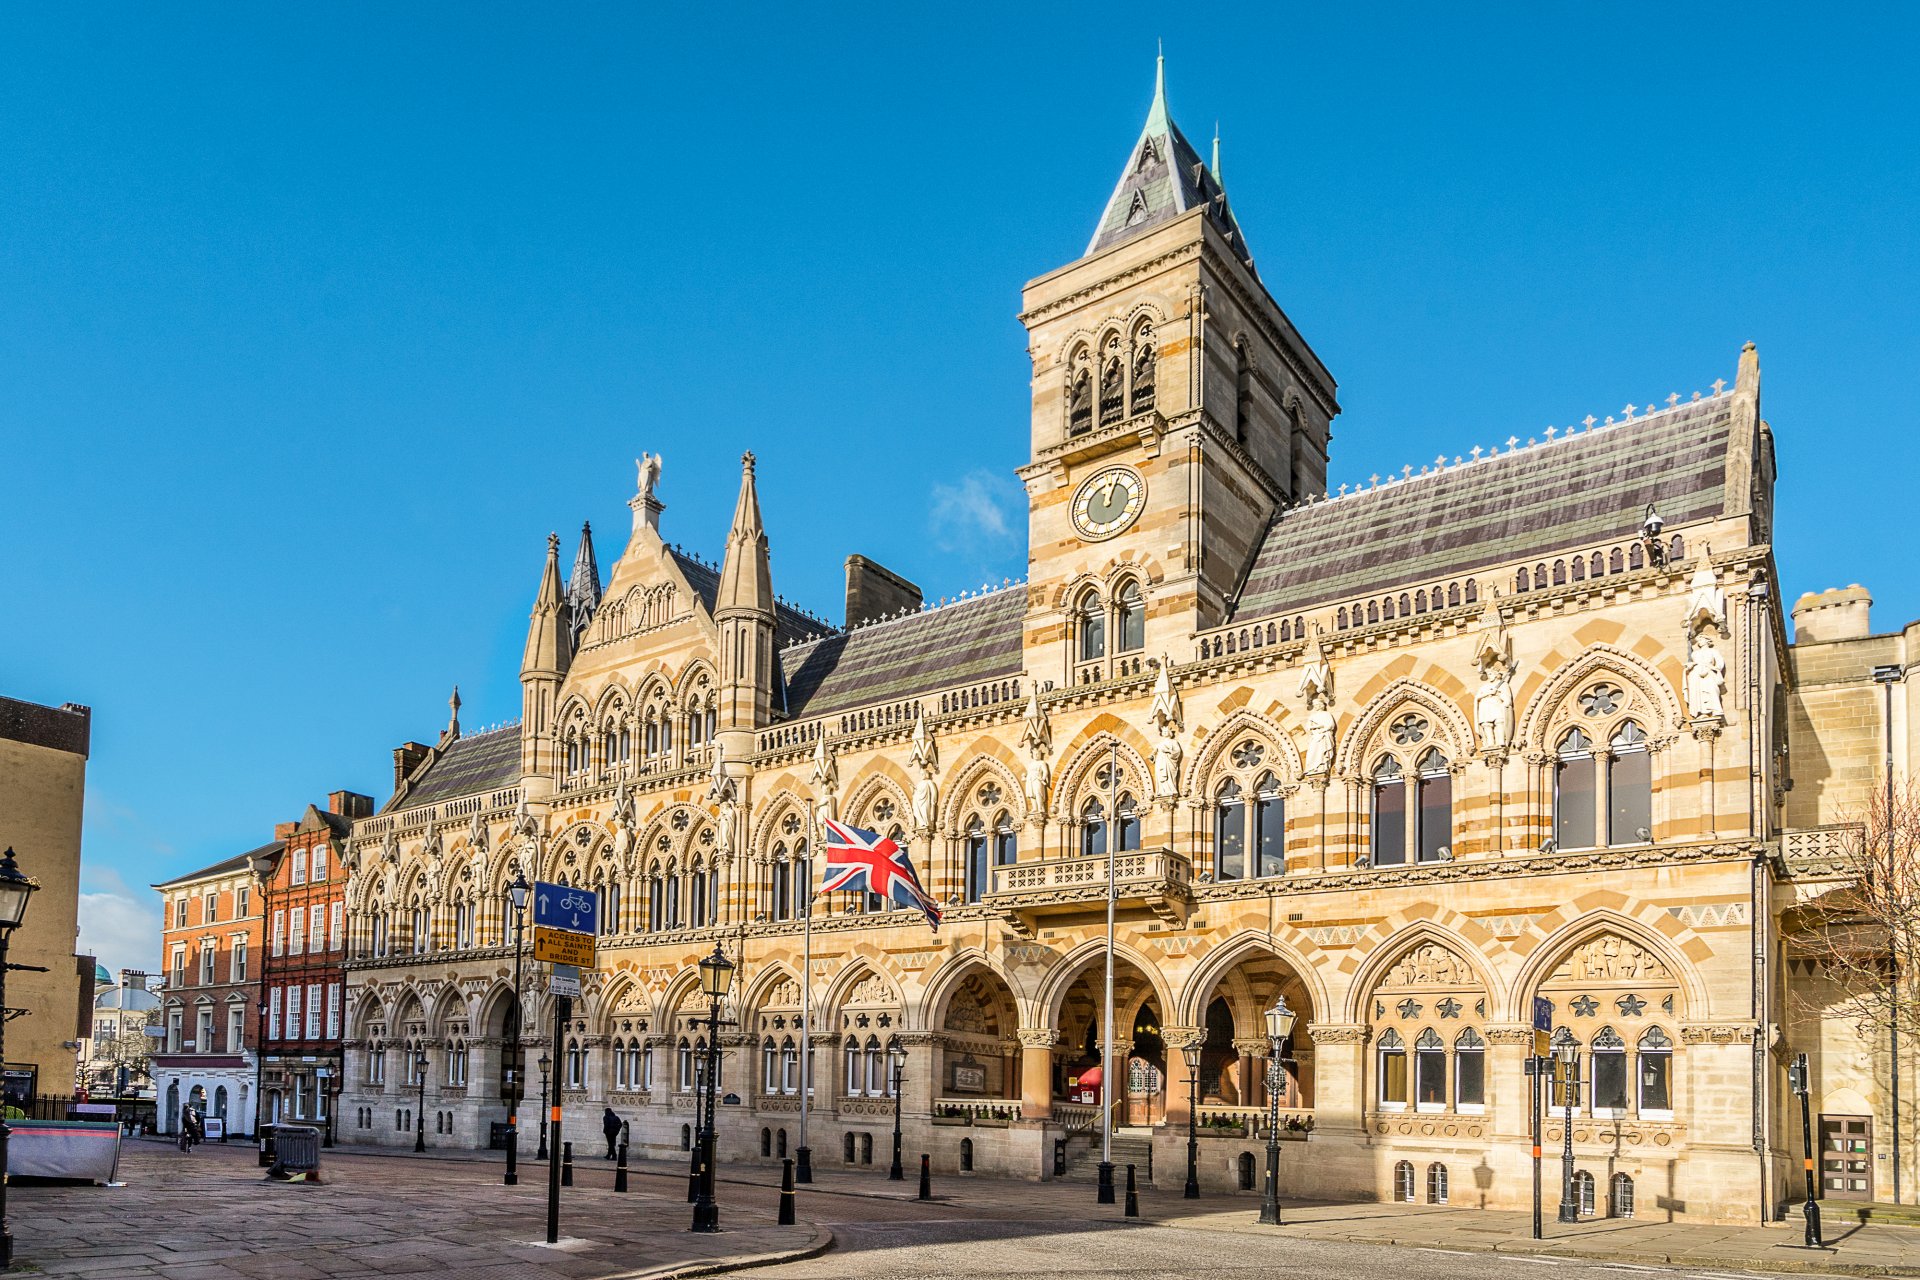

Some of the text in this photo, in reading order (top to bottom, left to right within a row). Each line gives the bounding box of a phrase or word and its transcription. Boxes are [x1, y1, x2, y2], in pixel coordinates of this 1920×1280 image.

[548, 932, 581, 942] ACCESS
[548, 938, 592, 951] ALL SAINTS
[562, 948, 579, 956] AND
[549, 953, 579, 962] BRIDGE
